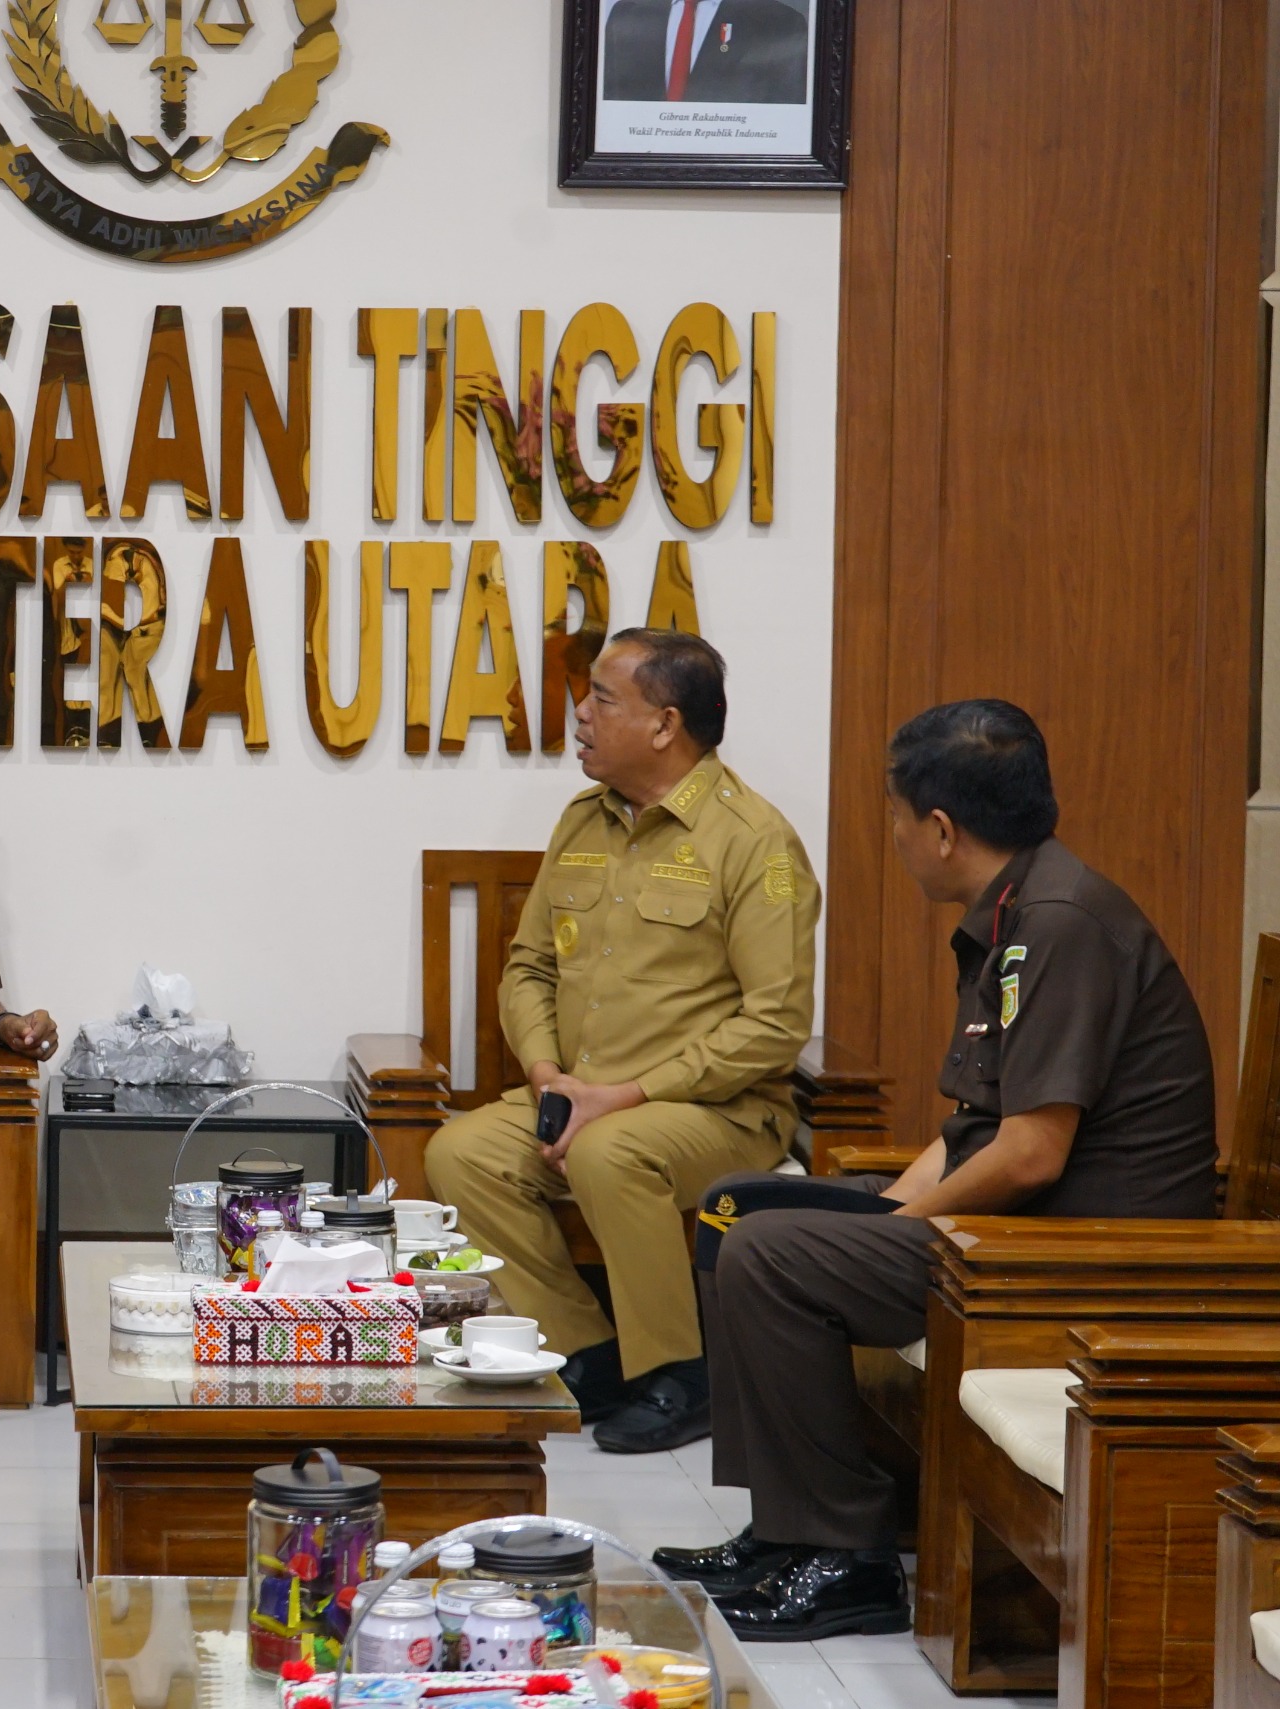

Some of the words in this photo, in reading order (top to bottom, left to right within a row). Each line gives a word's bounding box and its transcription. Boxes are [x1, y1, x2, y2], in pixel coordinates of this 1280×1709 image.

[628, 126, 653, 136] Wakil
[654, 127, 692, 137] Presiden
[693, 128, 733, 139] Republik
[734, 128, 778, 138] Indonesia
[658, 111, 690, 122] Gibran
[691, 112, 748, 124] Rakabuming
[7, 153, 83, 227] SATYA
[88, 215, 163, 251] ADHI
[172, 161, 336, 250] WICAKSANA
[357, 302, 778, 529] TINGGI
[228, 1320, 390, 1362] HORAS
